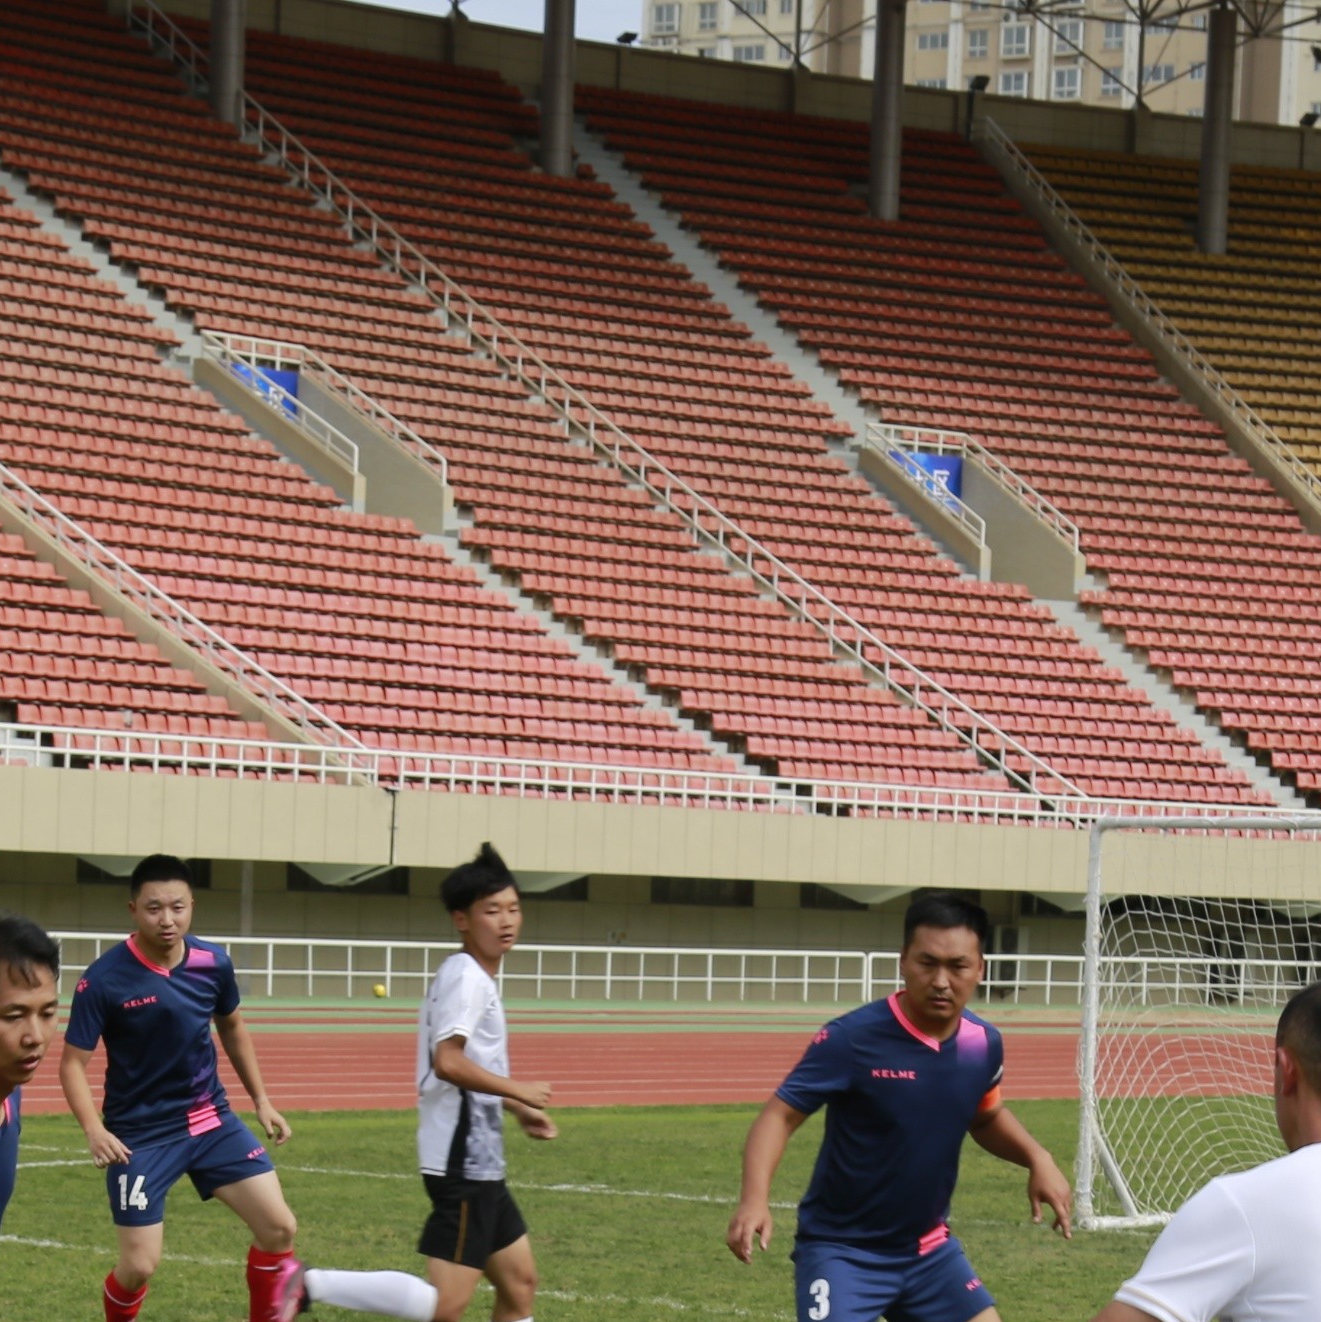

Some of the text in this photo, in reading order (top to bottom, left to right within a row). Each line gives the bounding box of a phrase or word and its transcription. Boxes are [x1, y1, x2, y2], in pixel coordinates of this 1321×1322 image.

[123, 995, 157, 1009] KELME
[871, 1068, 917, 1080] KELME
[118, 1174, 148, 1211] 14
[808, 1278, 830, 1321] 3
